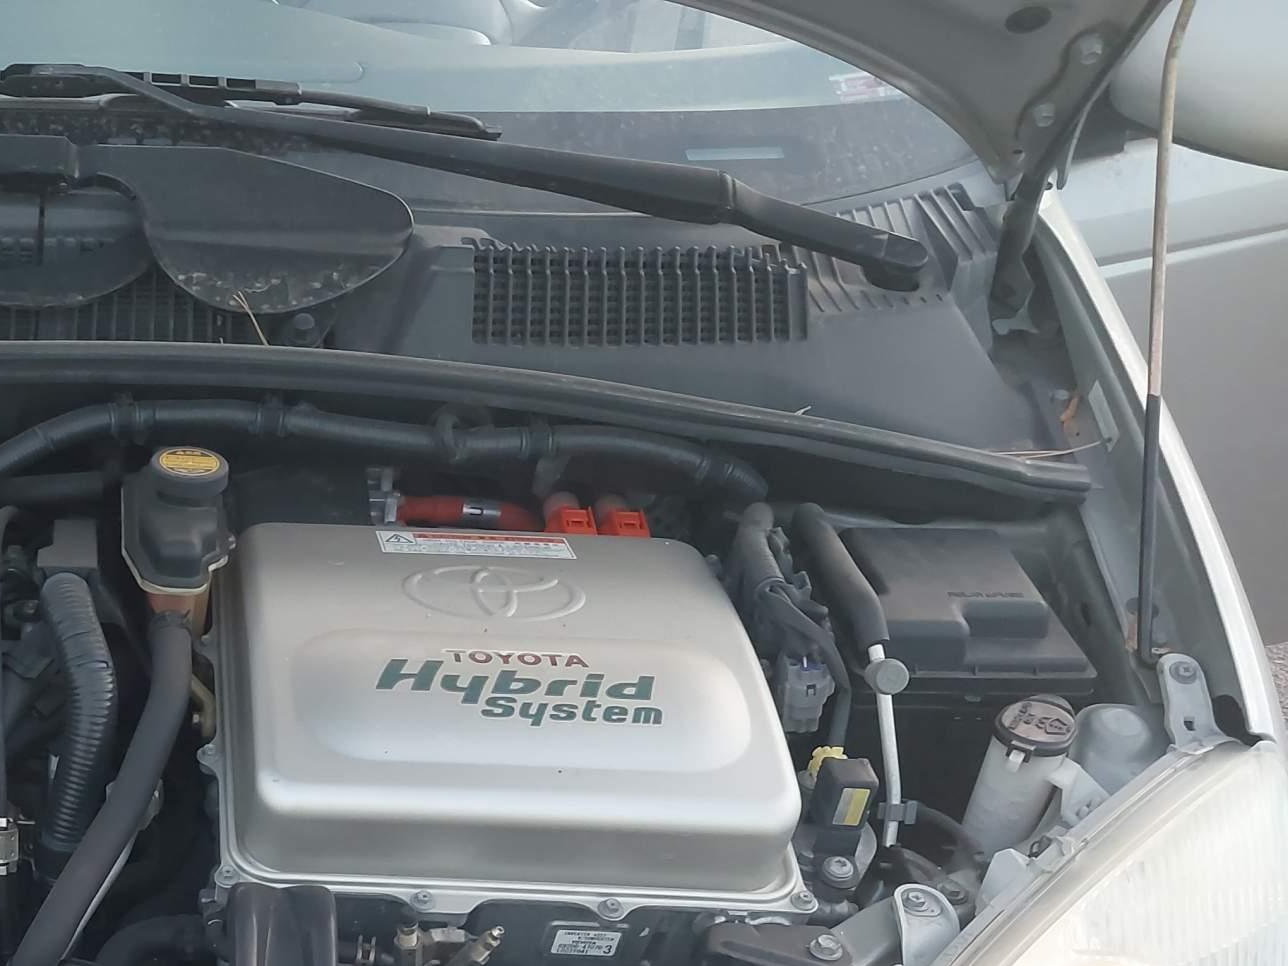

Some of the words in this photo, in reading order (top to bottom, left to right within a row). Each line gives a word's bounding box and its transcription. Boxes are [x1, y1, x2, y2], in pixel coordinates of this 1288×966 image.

[444, 649, 590, 668] TOYOTA
[374, 658, 656, 705] Hybrid
[479, 696, 663, 727] System
[603, 944, 613, 954] 3
